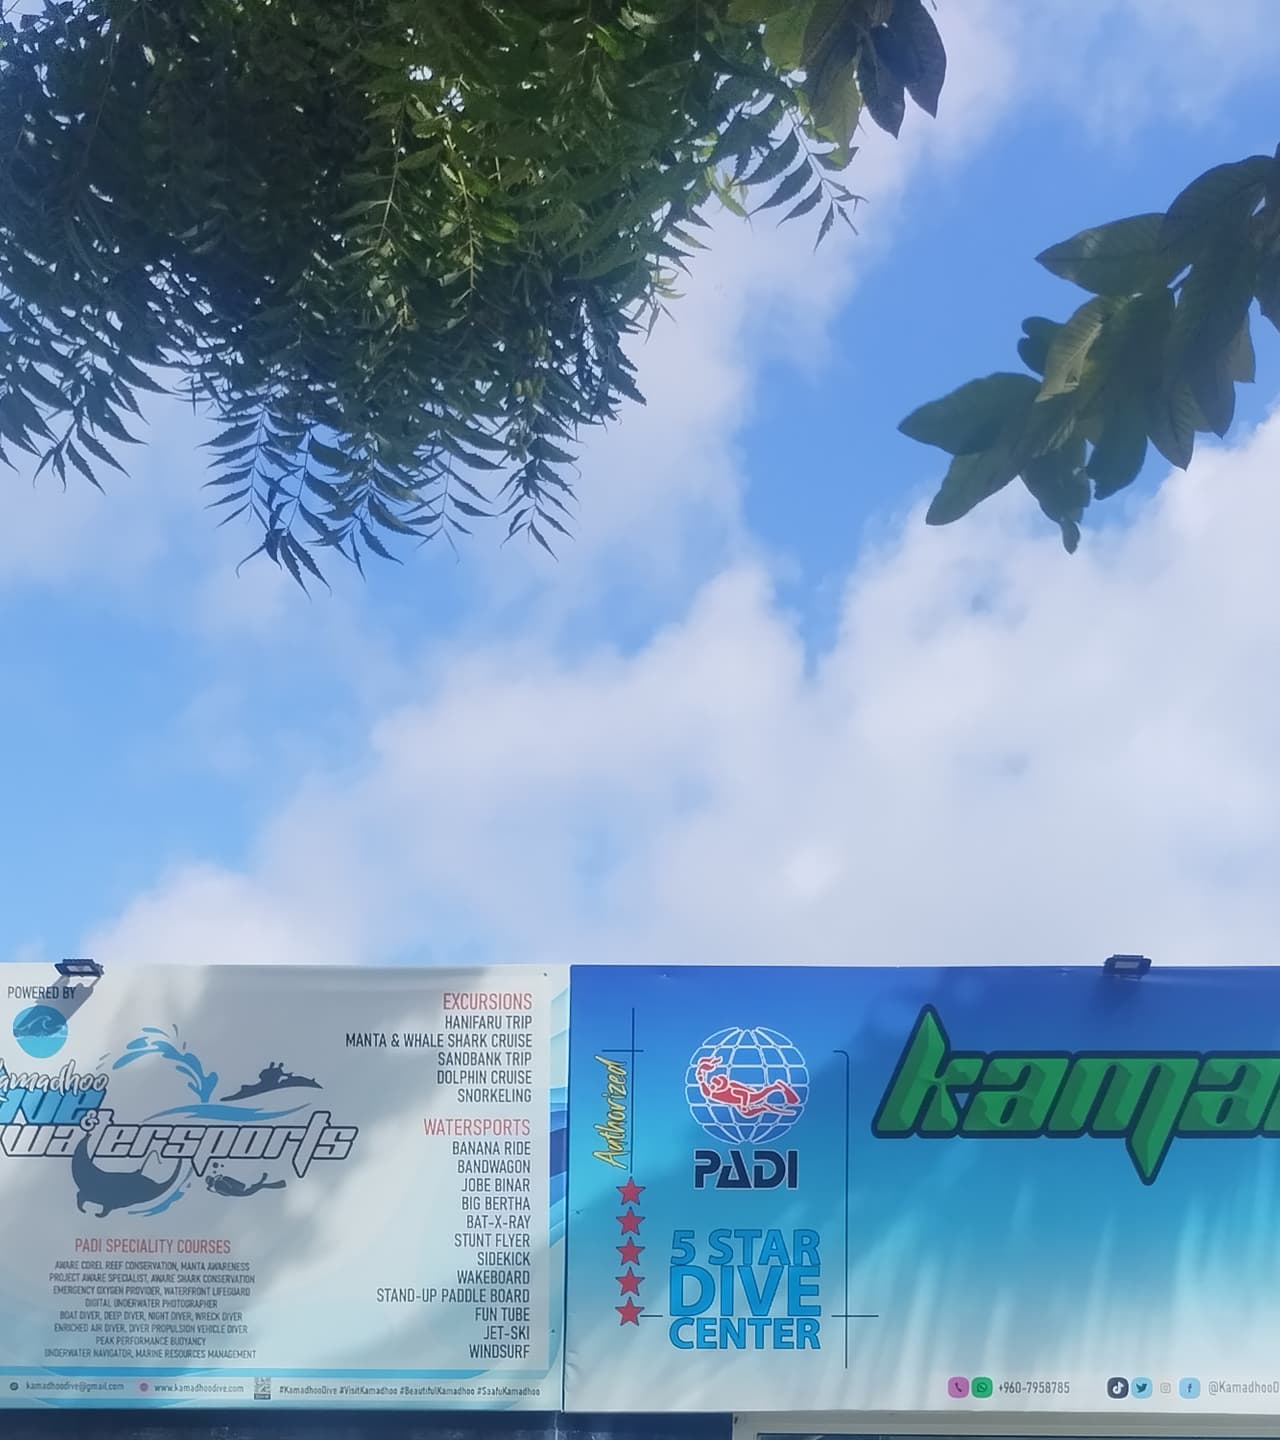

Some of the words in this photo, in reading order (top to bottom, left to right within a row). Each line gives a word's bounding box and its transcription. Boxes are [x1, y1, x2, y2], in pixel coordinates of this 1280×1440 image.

[8, 986, 59, 999] POWERED
[62, 987, 76, 999] BY
[443, 992, 532, 1010] EXCURSIONS
[445, 1015, 502, 1029] HANIFARU
[506, 1016, 532, 1029] TRIP
[346, 1033, 387, 1047] MANTA
[391, 1033, 400, 1047] &
[404, 1033, 444, 1047] WHALE
[448, 1034, 488, 1047] SHARK
[491, 1034, 532, 1047] CRUISE
[438, 1052, 502, 1066] SANDBANK
[506, 1052, 532, 1066] TRIP
[437, 1070, 487, 1084] DOLPHIN
[491, 1070, 532, 1084] CRUISE
[457, 1088, 531, 1103] SNORKELING
[424, 1118, 530, 1136] WATERSPORTS
[452, 1141, 500, 1155] BANANA
[504, 1141, 531, 1155] RIDE
[458, 1159, 530, 1173] BANDWAGON
[693, 1149, 799, 1189] PADI
[461, 1178, 491, 1192] JOBE
[495, 1178, 530, 1192] BINAR
[462, 1196, 481, 1210] BIG
[485, 1196, 531, 1210] BERTHA
[466, 1215, 531, 1229] BAT-X-RAY
[75, 1238, 101, 1253] PADI
[105, 1238, 173, 1253] SPECIALITY
[177, 1239, 231, 1254] COURSES
[455, 1233, 492, 1247] STUNT
[495, 1233, 530, 1247] FLYER
[671, 1229, 696, 1266] 5
[708, 1229, 821, 1266] STAR
[477, 1252, 531, 1266] SIDEKICK
[457, 1270, 530, 1285] WAKEBOARD
[376, 1288, 437, 1302] STAND-UP
[441, 1289, 486, 1303] PADDLE
[490, 1289, 530, 1303] BOARD
[669, 1265, 821, 1317] DIVE
[475, 1307, 497, 1321] FUN
[501, 1307, 530, 1321] TUBE
[483, 1326, 530, 1340] JET-SKI
[669, 1317, 821, 1350] CENTER
[469, 1344, 530, 1358] WINDSURF
[998, 1380, 1070, 1395] +960-7958785
